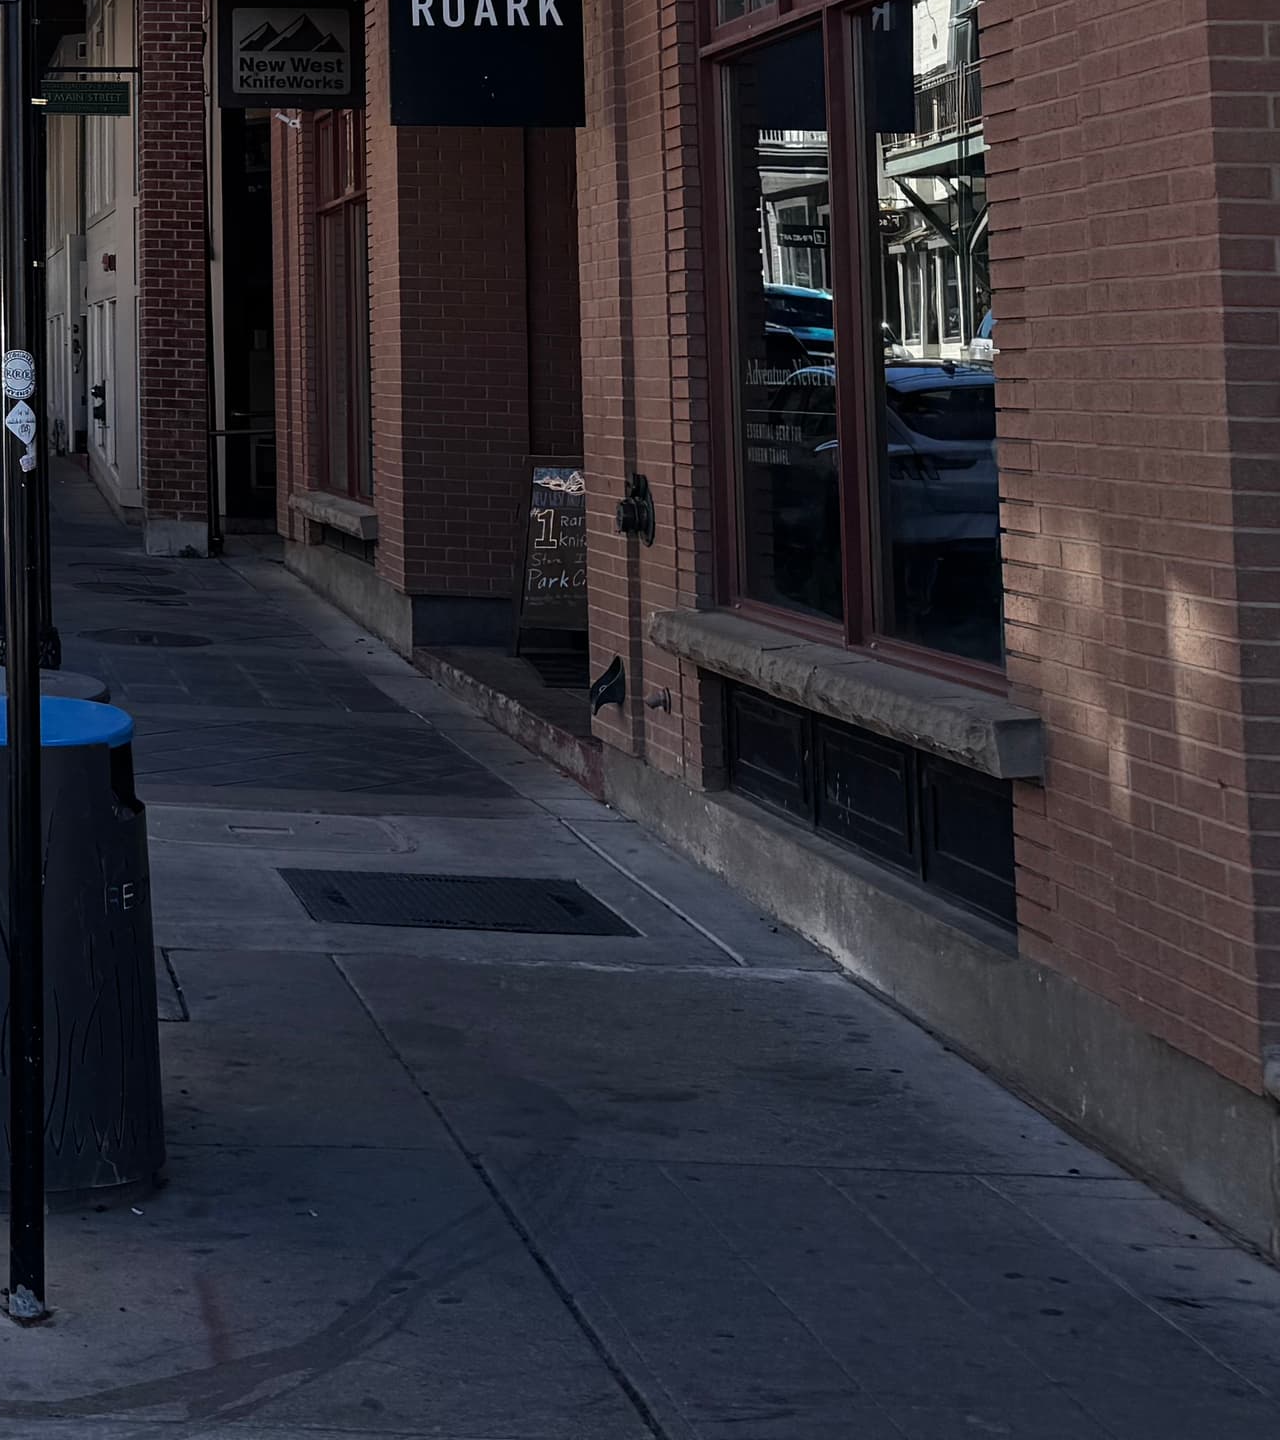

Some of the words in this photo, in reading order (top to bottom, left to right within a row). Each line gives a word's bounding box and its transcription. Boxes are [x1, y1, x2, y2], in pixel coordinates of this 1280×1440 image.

[239, 56, 286, 73] New
[290, 56, 344, 73] West
[239, 75, 345, 89] KnifeWorks
[54, 93, 83, 102] MAIN
[88, 93, 122, 102] STREET
[745, 359, 791, 385] Adventure
[792, 359, 824, 386] Never
[746, 423, 773, 440] ESSENTIAL
[528, 568, 569, 590] Park
